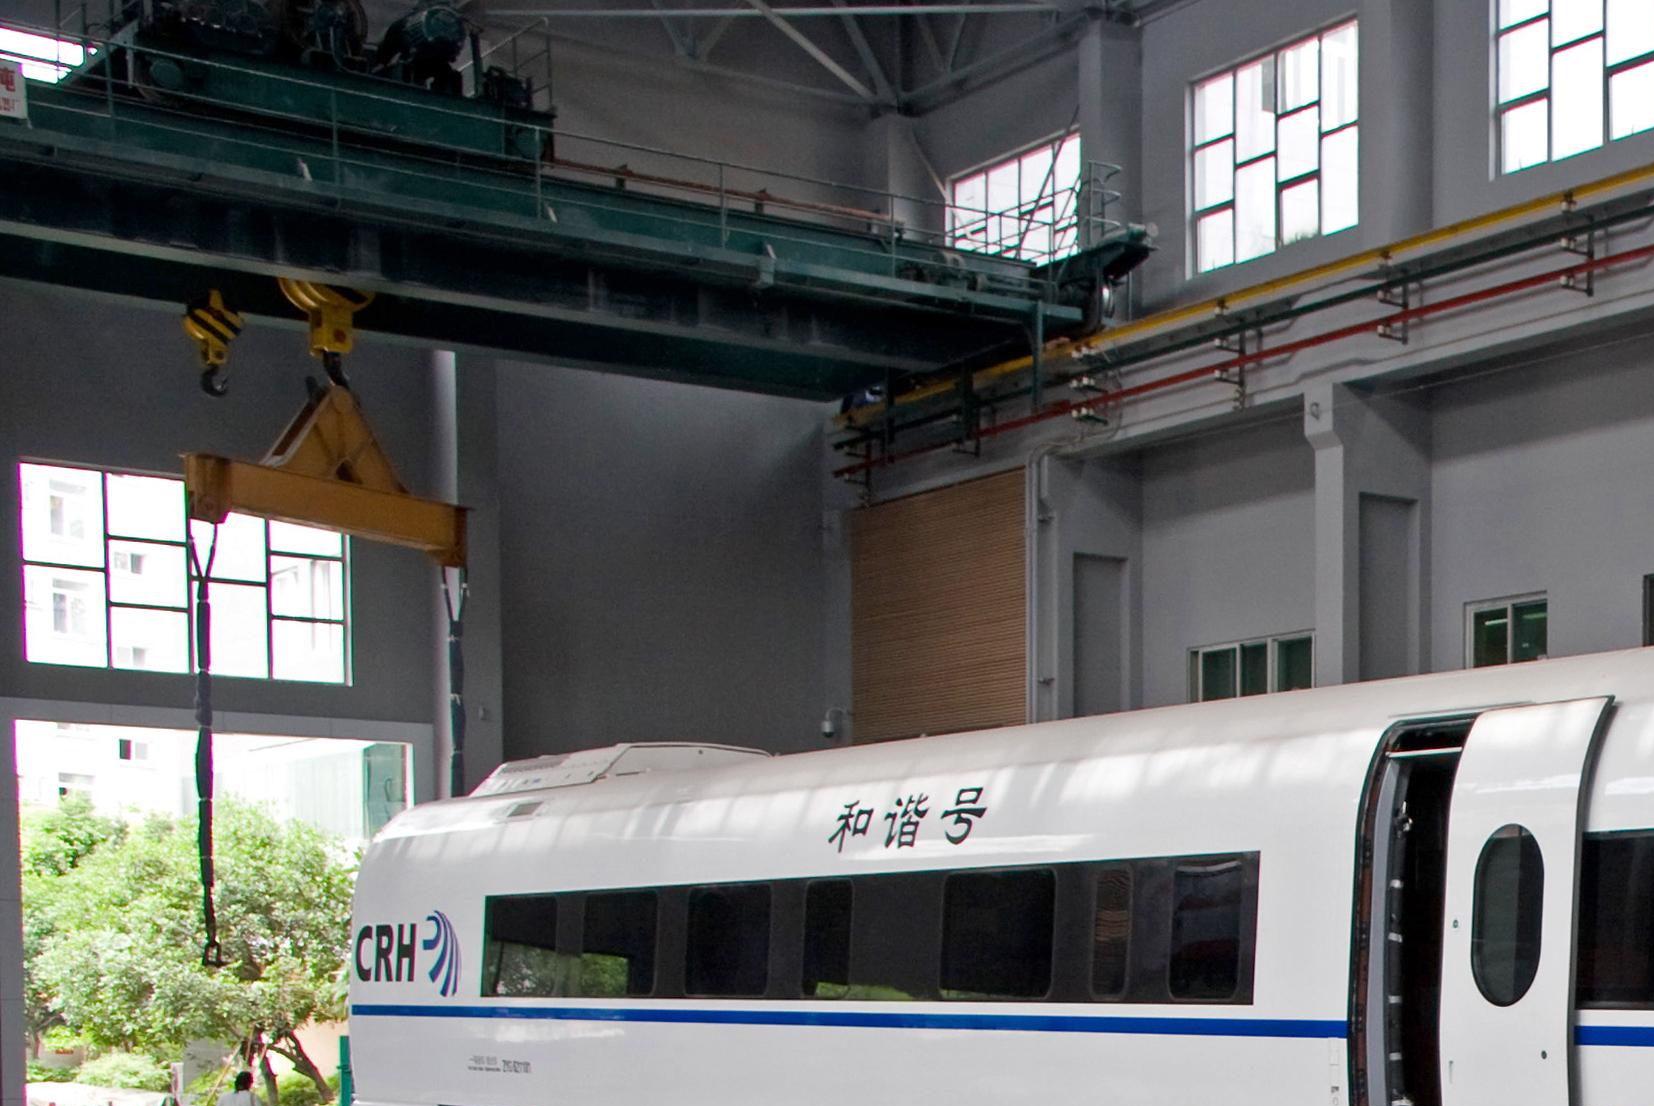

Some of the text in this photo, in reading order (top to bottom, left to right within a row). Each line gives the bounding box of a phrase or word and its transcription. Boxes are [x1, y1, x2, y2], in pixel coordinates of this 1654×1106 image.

[828, 787, 988, 853] 和谐号
[355, 923, 417, 982] CRH
